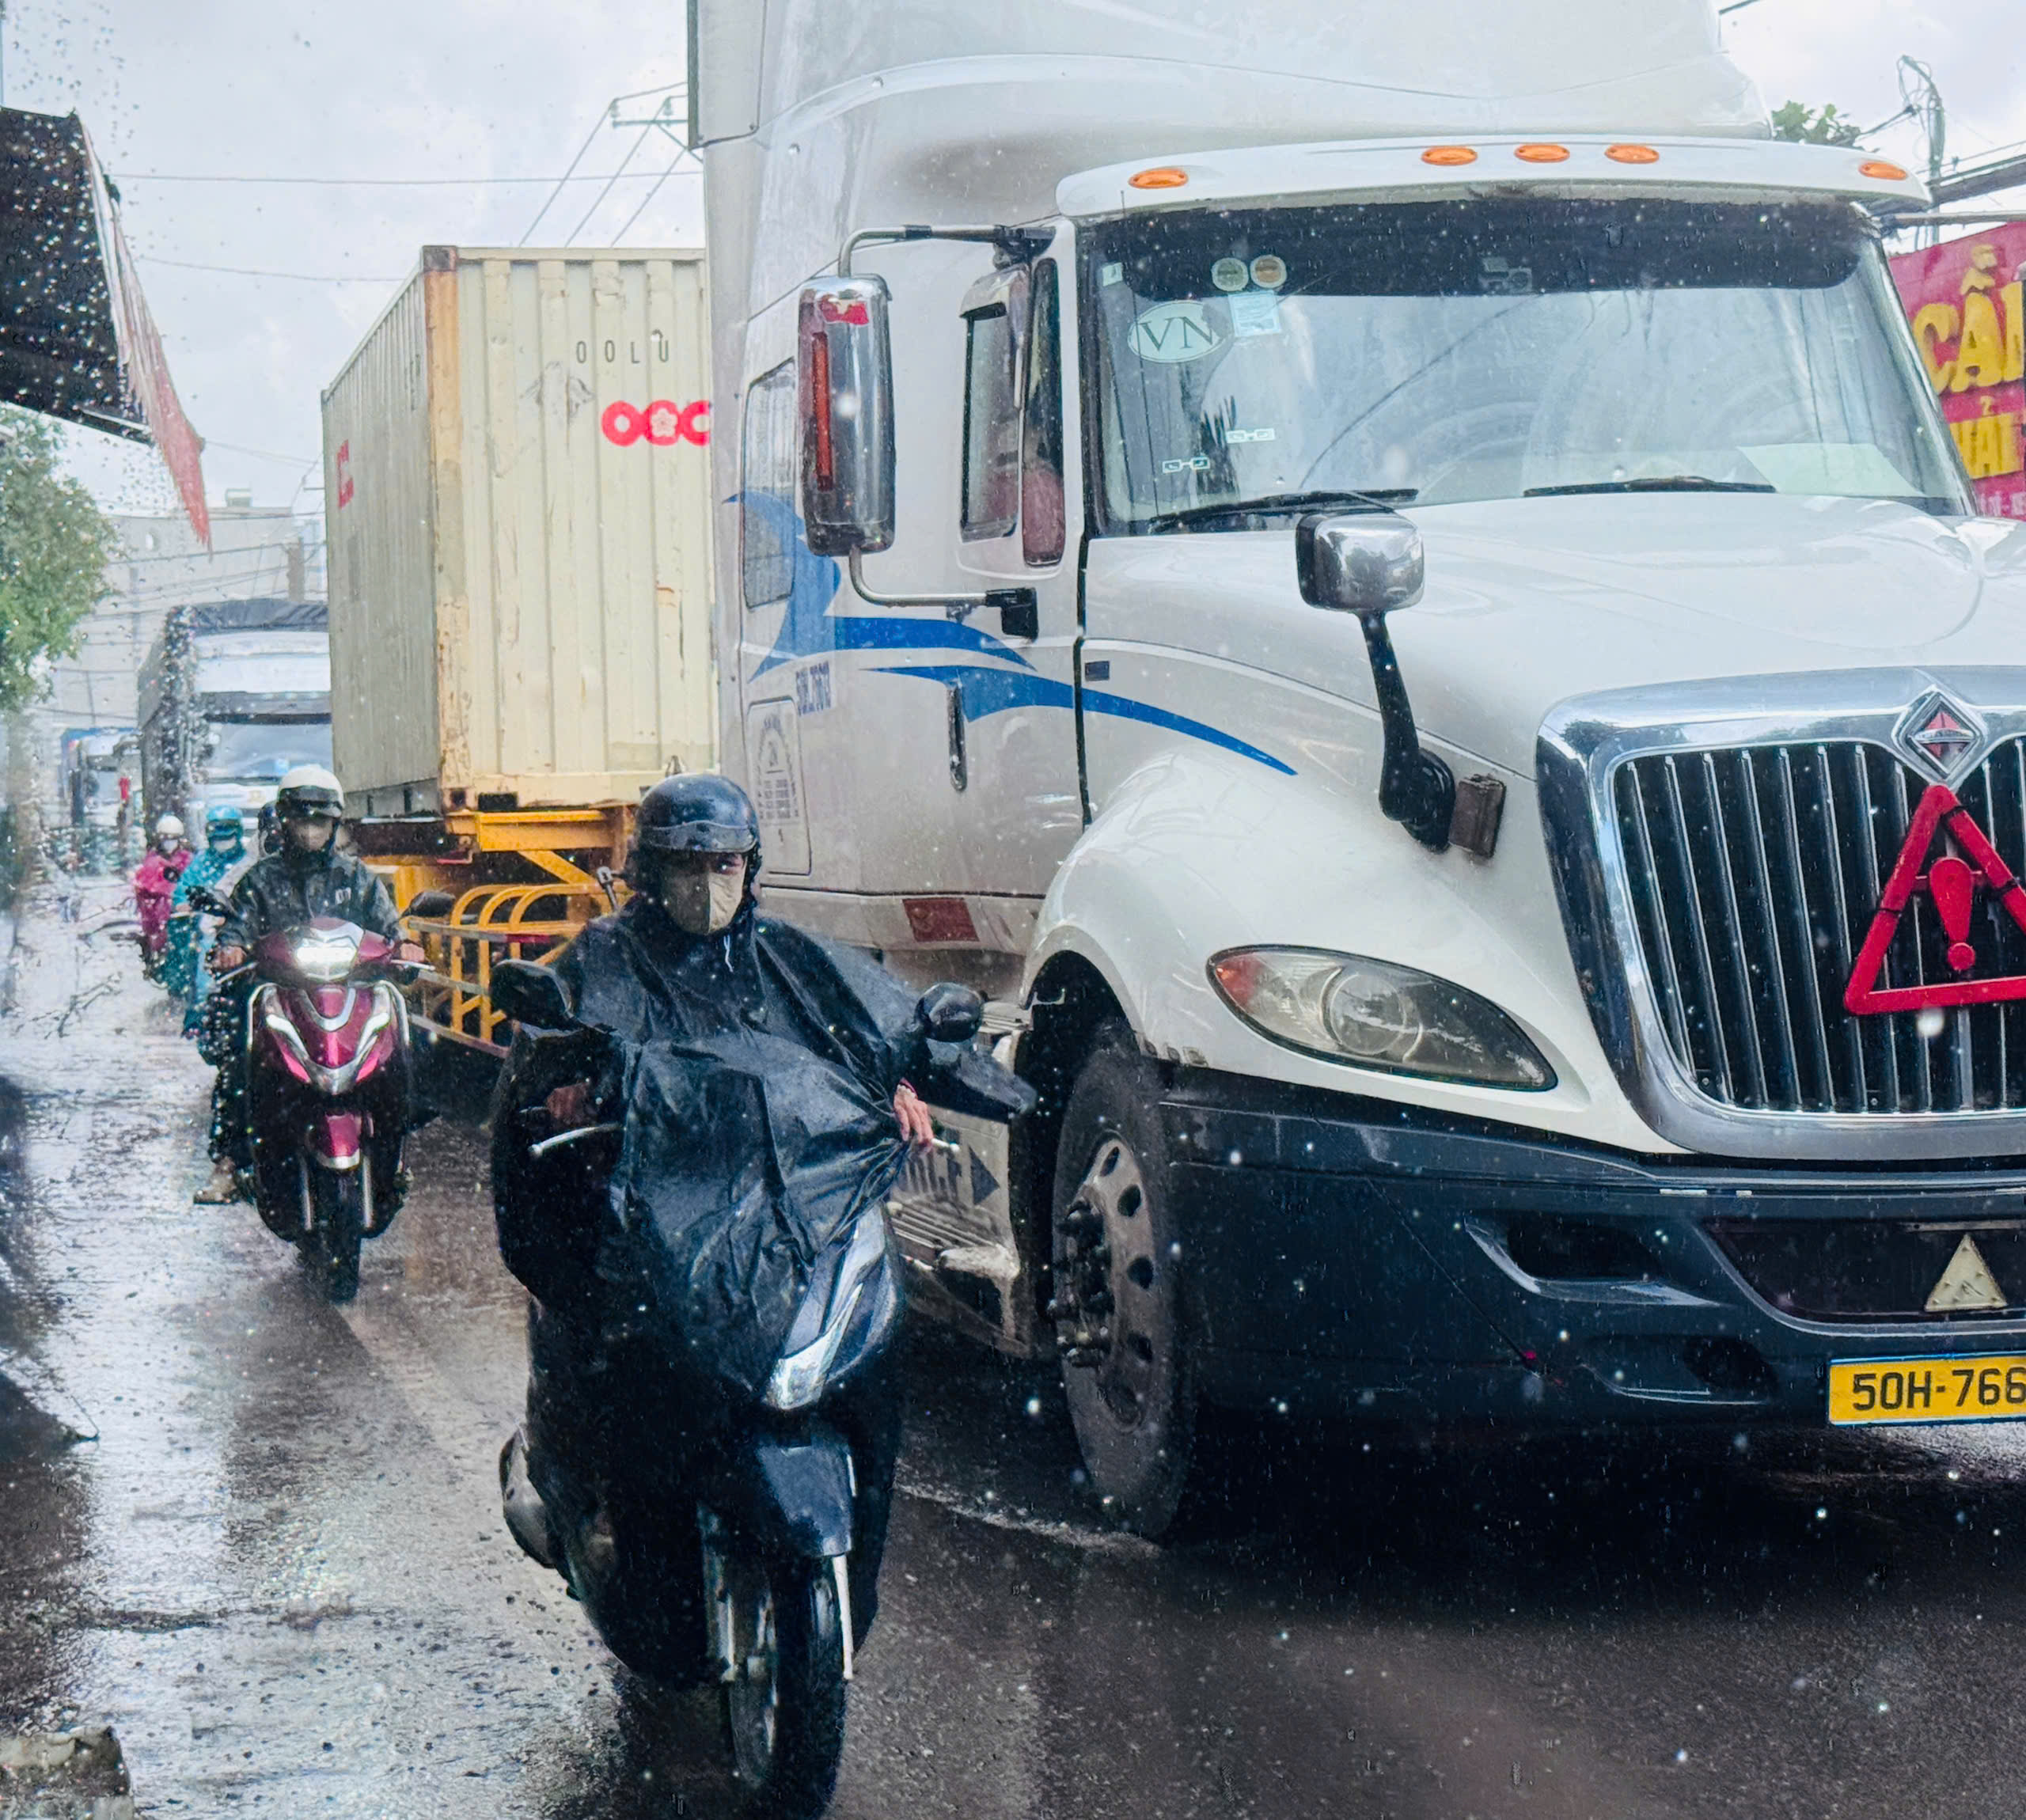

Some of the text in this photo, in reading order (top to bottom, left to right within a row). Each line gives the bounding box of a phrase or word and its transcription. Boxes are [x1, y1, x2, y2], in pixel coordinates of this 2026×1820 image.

[1140, 316, 1213, 351] VN
[575, 340, 670, 363] OOLU
[1852, 1367, 2026, 1411] 50H-766
